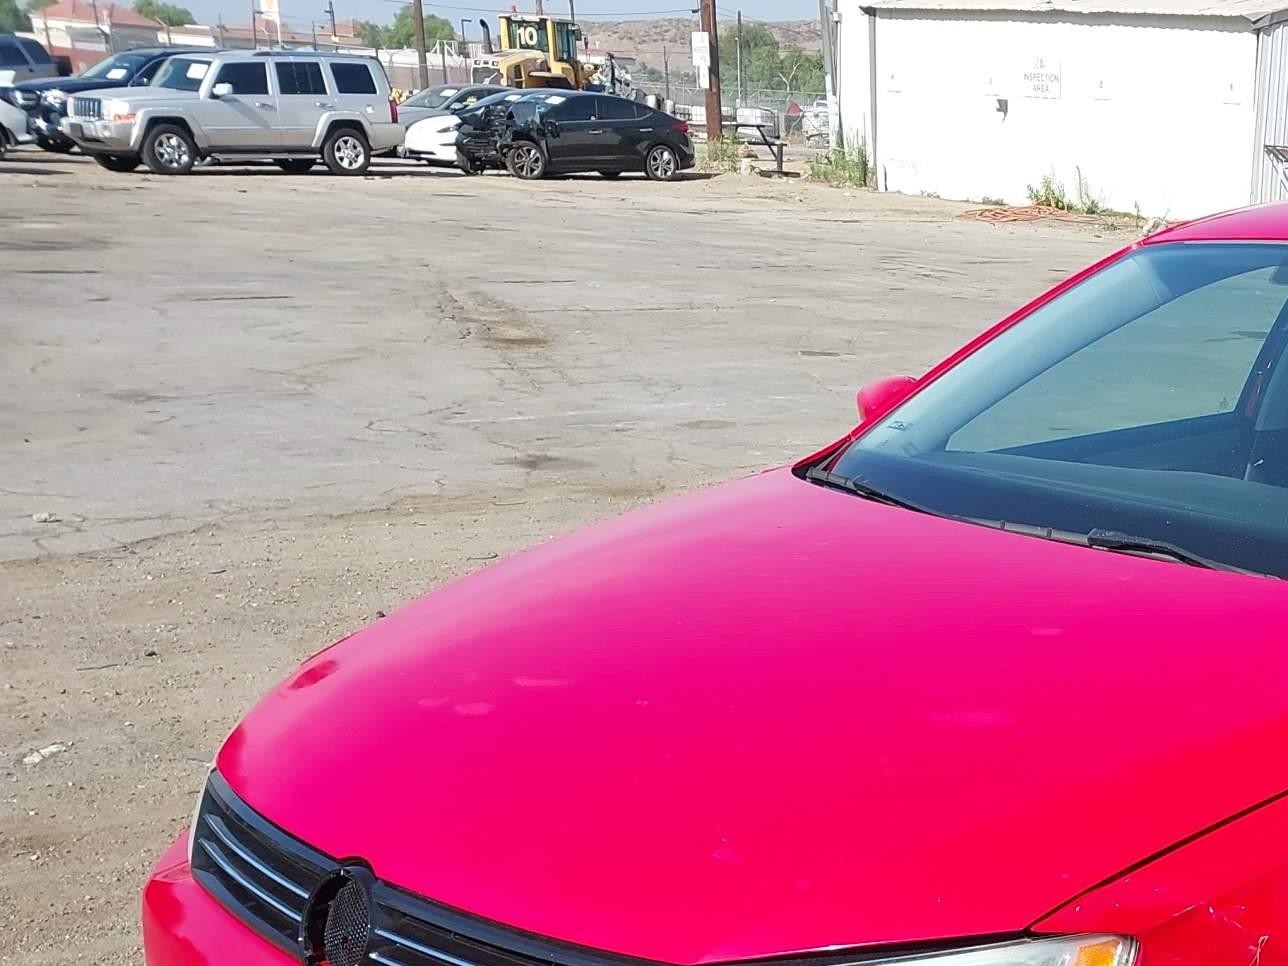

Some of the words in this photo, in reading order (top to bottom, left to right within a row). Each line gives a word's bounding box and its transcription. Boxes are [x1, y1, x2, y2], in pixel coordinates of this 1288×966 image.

[517, 26, 537, 45] 10
[1023, 73, 1059, 83] INSPECTION
[1032, 84, 1050, 93] AREA
